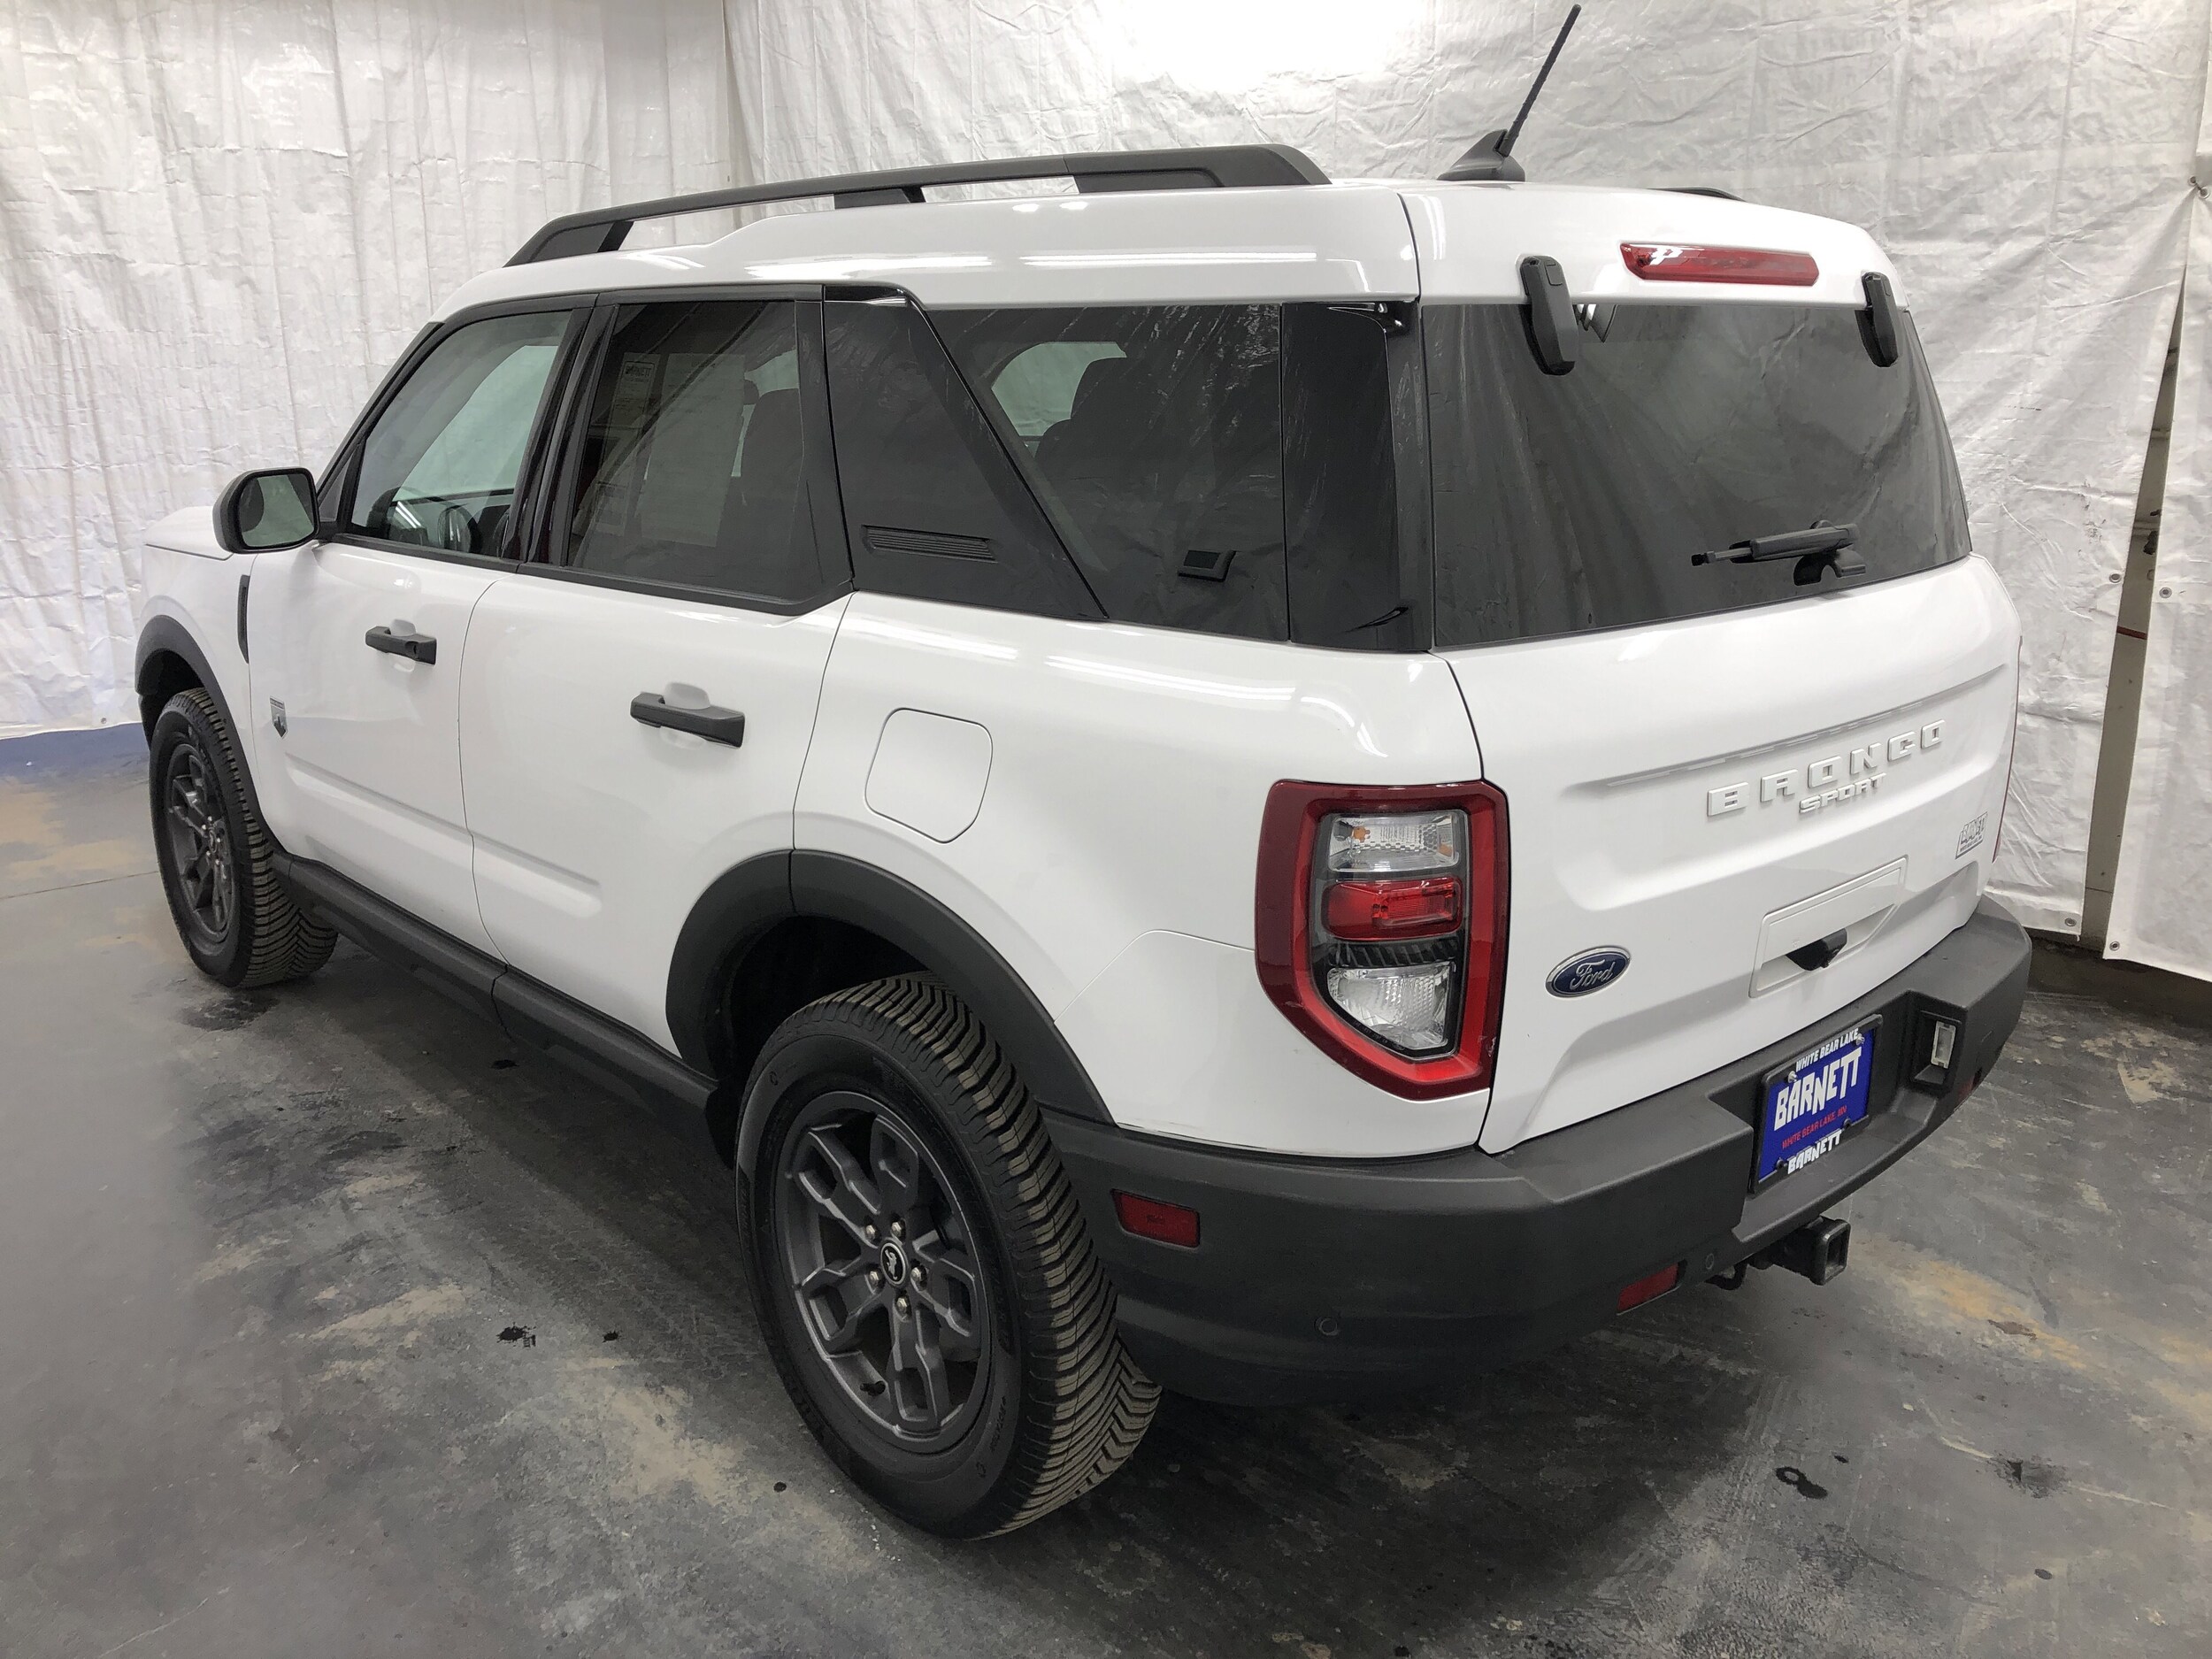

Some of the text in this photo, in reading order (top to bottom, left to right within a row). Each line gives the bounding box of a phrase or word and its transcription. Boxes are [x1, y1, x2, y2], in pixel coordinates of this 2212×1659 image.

[1707, 719, 1946, 818] BRONCO
[1799, 772, 1887, 814] SPORT
[1569, 958, 1617, 990] Ford
[1795, 1027, 1859, 1072] WHITE BEAR LAKE
[1773, 1046, 1863, 1132] BARNETT
[1787, 1128, 1842, 1175] BARNETT
[1801, 1121, 1819, 1139] BEAR
